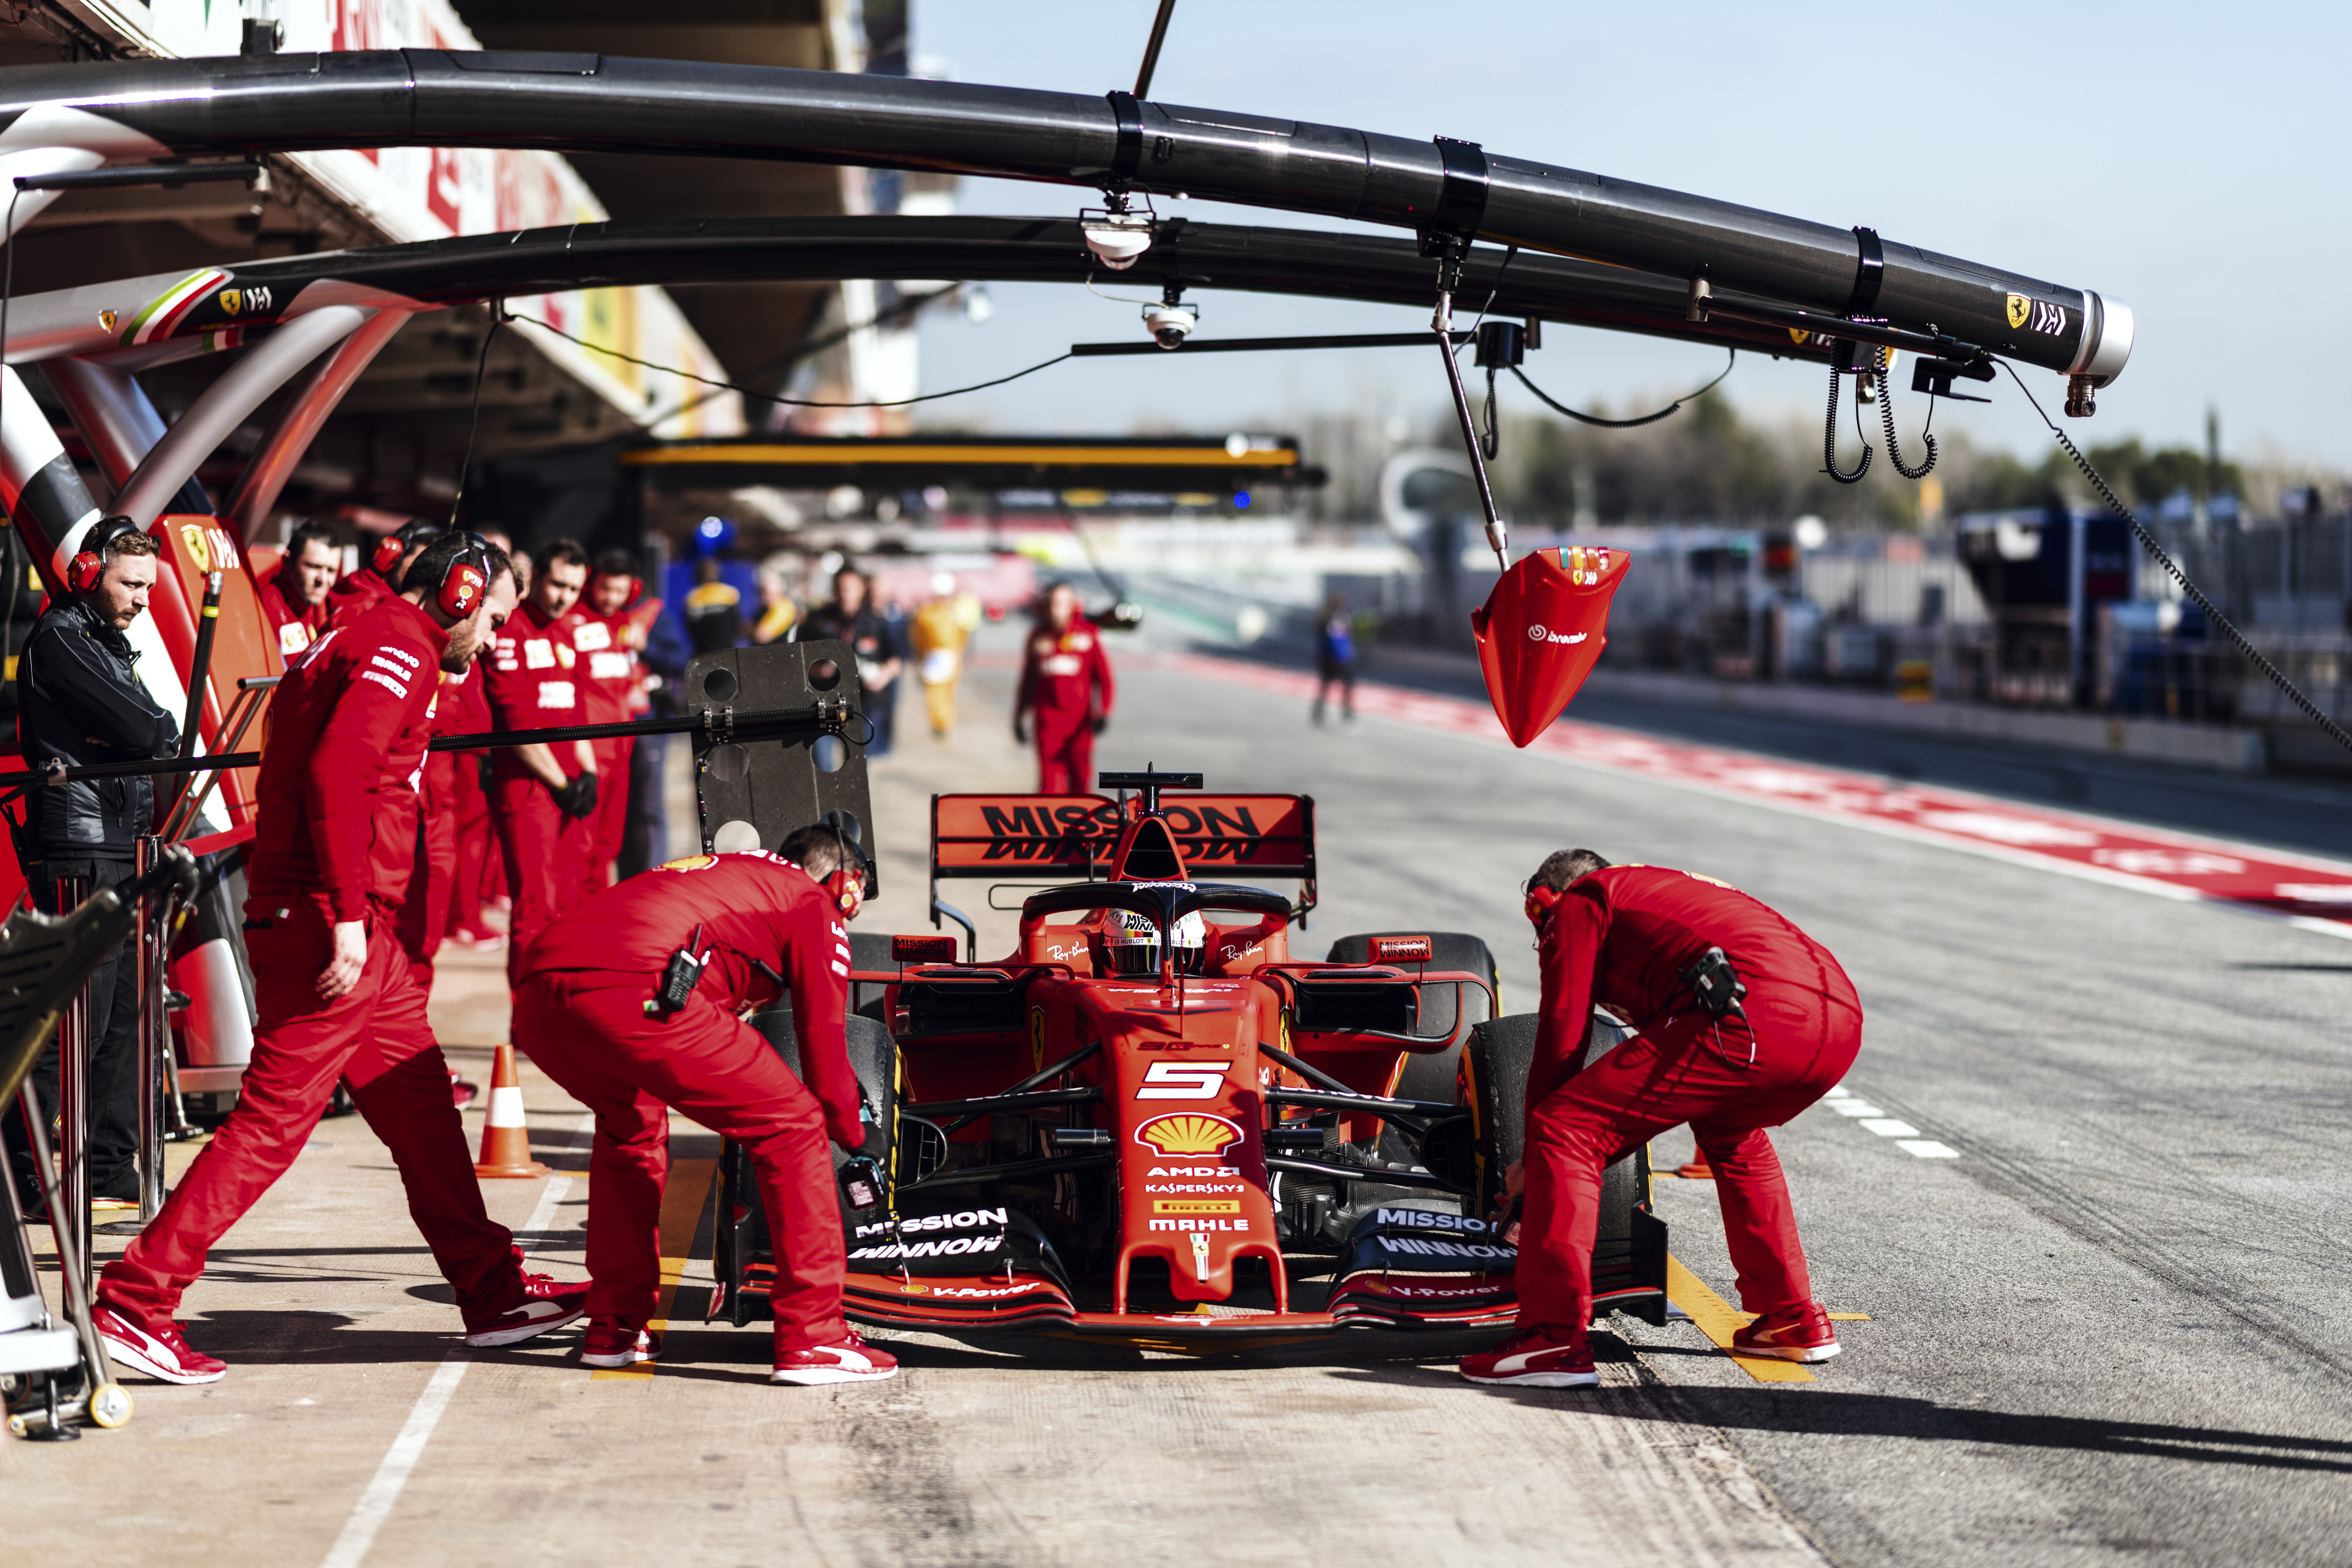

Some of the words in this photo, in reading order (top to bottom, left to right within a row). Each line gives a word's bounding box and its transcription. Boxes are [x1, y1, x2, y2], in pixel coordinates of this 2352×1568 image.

[980, 805, 1262, 837] MISSON
[895, 938, 948, 947] MISSION
[1379, 940, 1428, 949] MISSION
[894, 947, 947, 956] WINNOW
[1379, 948, 1429, 958] WINNOW
[1135, 1060, 1234, 1099] 5
[1147, 1167, 1215, 1176] AMD
[1145, 1183, 1235, 1194] KASPERSKY
[1149, 1219, 1249, 1231] MAHLE
[847, 1236, 1003, 1259] WINNOW
[934, 1282, 1040, 1297] V-Power
[1392, 1286, 1500, 1296] V-Power
